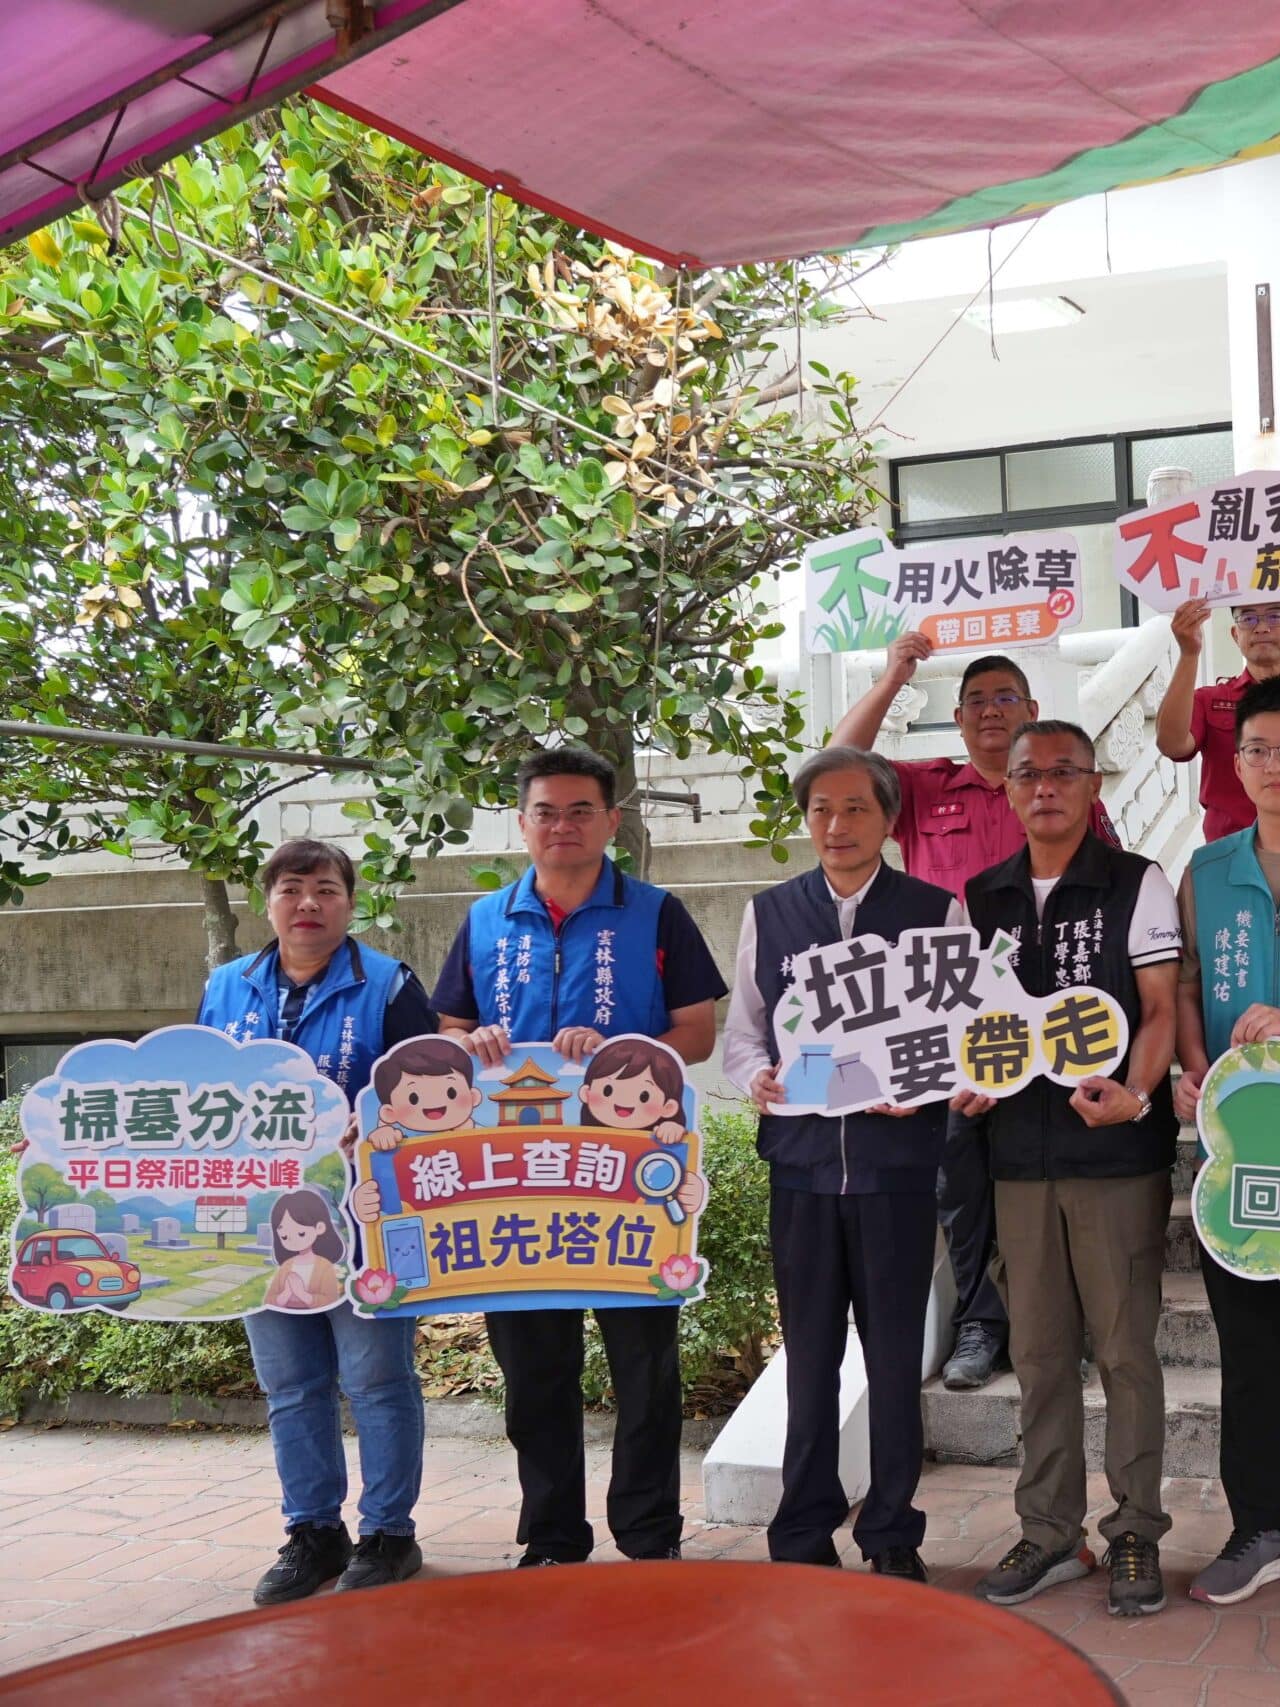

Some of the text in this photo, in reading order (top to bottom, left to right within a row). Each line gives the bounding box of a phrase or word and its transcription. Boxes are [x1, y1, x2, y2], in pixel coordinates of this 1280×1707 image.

[810, 537, 1077, 620] 不 用火除草
[1119, 501, 1207, 590] 不
[935, 609, 1041, 643] 帶回丟棄
[516, 935, 532, 984] 消防局
[593, 930, 616, 1025] 雲林縣政府
[805, 933, 983, 1034] 垃圾
[1072, 920, 1092, 984] 張嘉郡
[1213, 928, 1232, 1002] 陳建佑
[1234, 910, 1253, 988] 機要秘書
[885, 994, 1120, 1102] 要帶走
[59, 1087, 308, 1143] 掃墓分流
[67, 1158, 300, 1191] 平日祭祀避尖峰
[409, 1140, 628, 1203] 線上查詢
[430, 1213, 655, 1274] 祖先塔位
